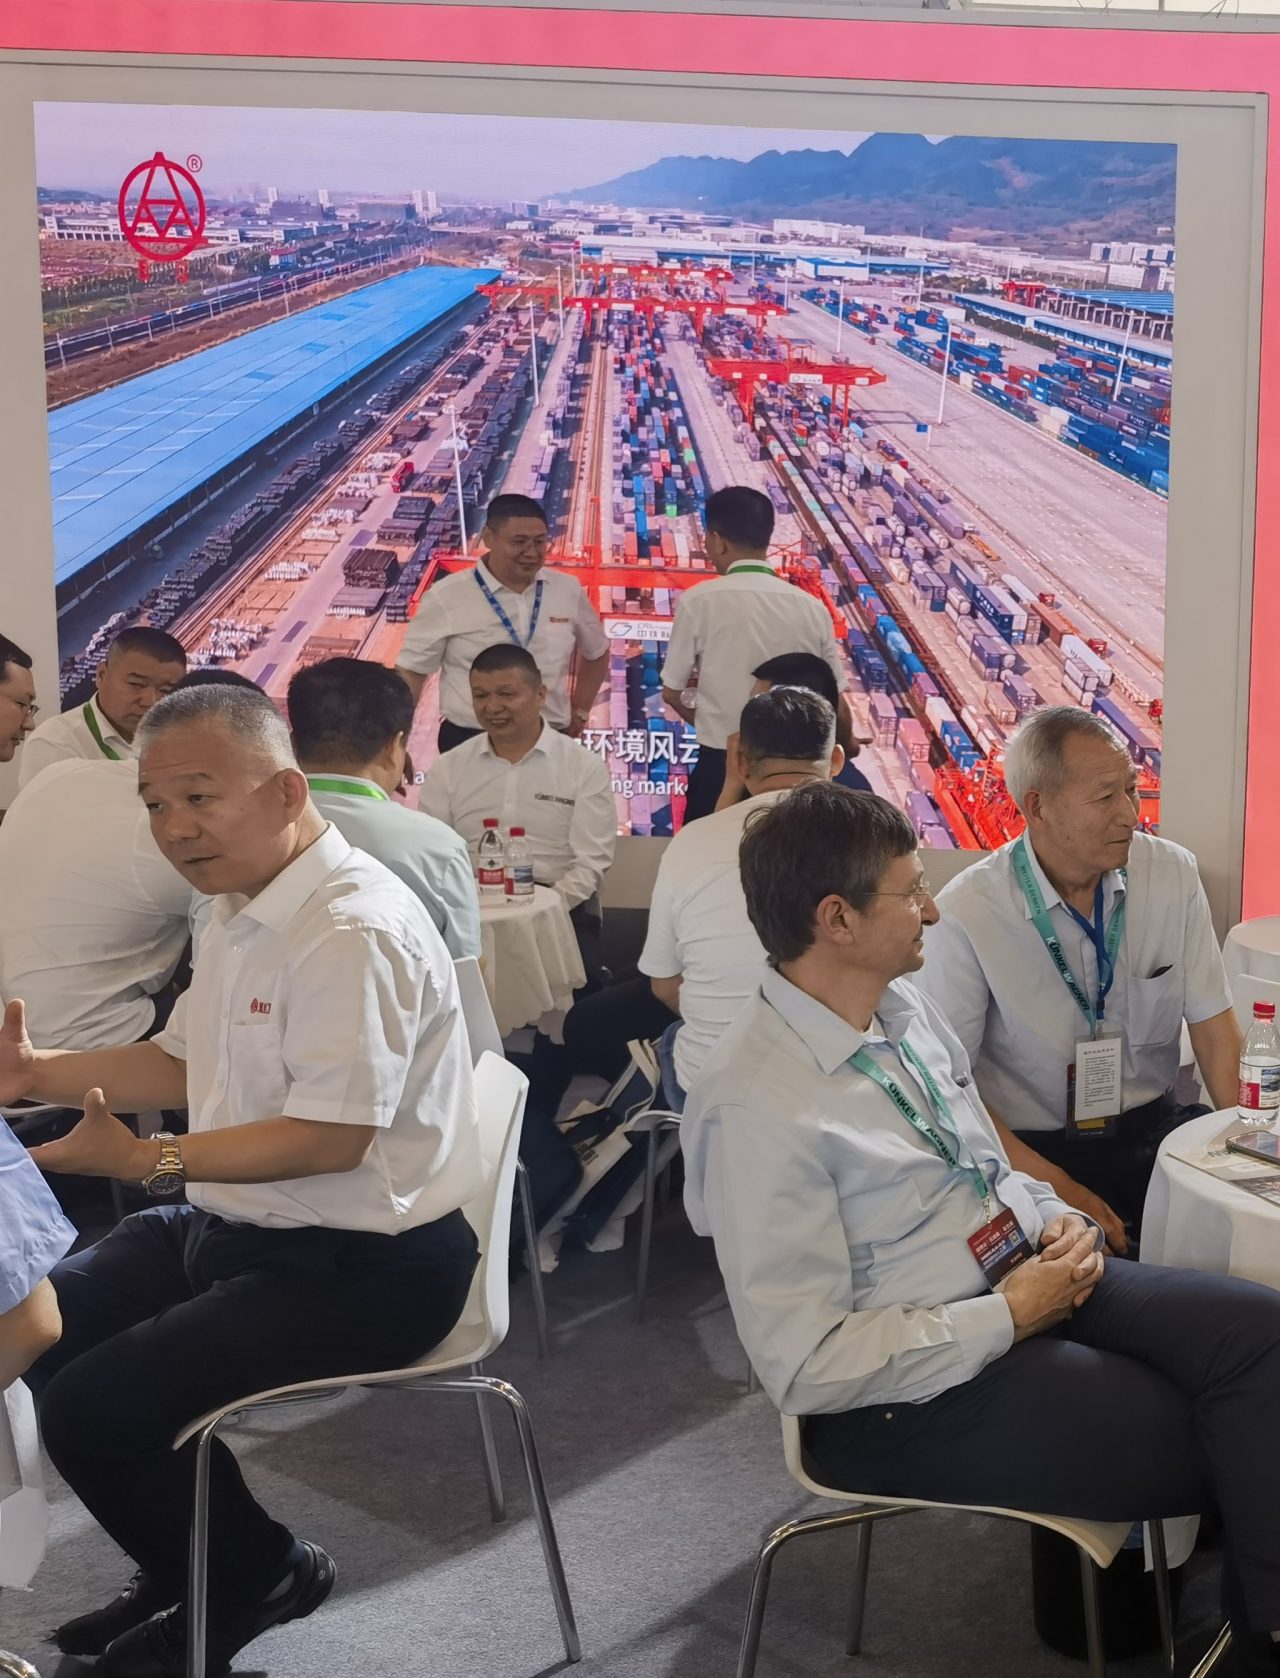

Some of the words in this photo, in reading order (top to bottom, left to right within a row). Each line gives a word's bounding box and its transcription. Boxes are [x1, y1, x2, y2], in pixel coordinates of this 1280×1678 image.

[573, 728, 701, 765] 环境风云
[610, 779, 634, 798] ng
[1045, 935, 1091, 1012] KÜNKELWAGNER
[881, 1075, 957, 1167] KÜNKELWAGNER
